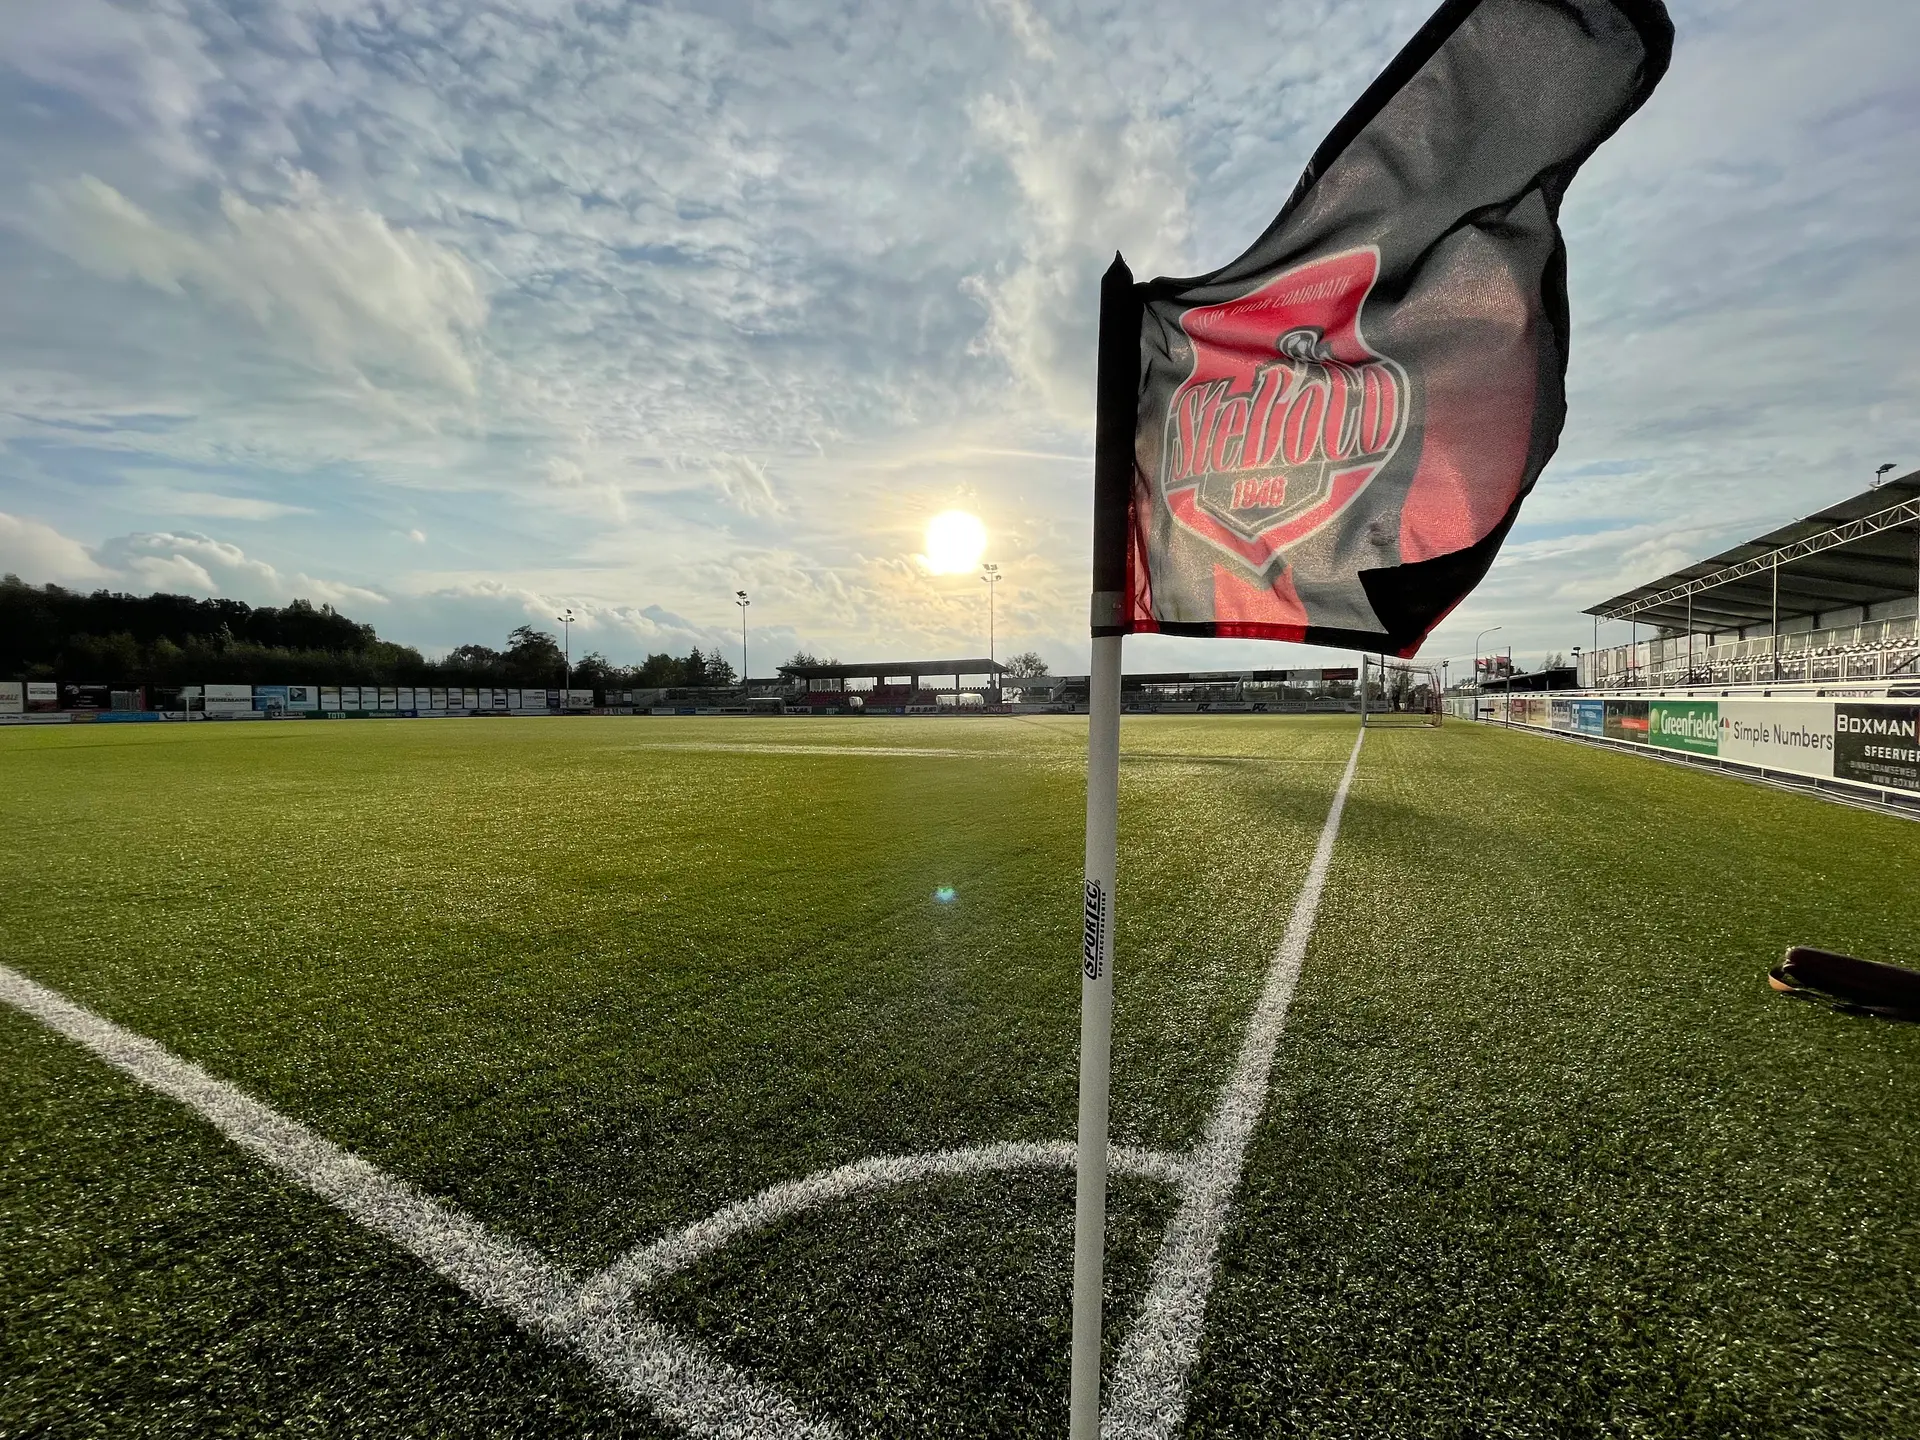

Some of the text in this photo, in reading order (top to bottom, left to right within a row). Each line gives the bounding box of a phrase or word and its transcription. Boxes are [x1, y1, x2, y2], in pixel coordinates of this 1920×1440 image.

[1734, 721, 1833, 750] Simple Numbers
[1084, 884, 1100, 974] SPORTEC
